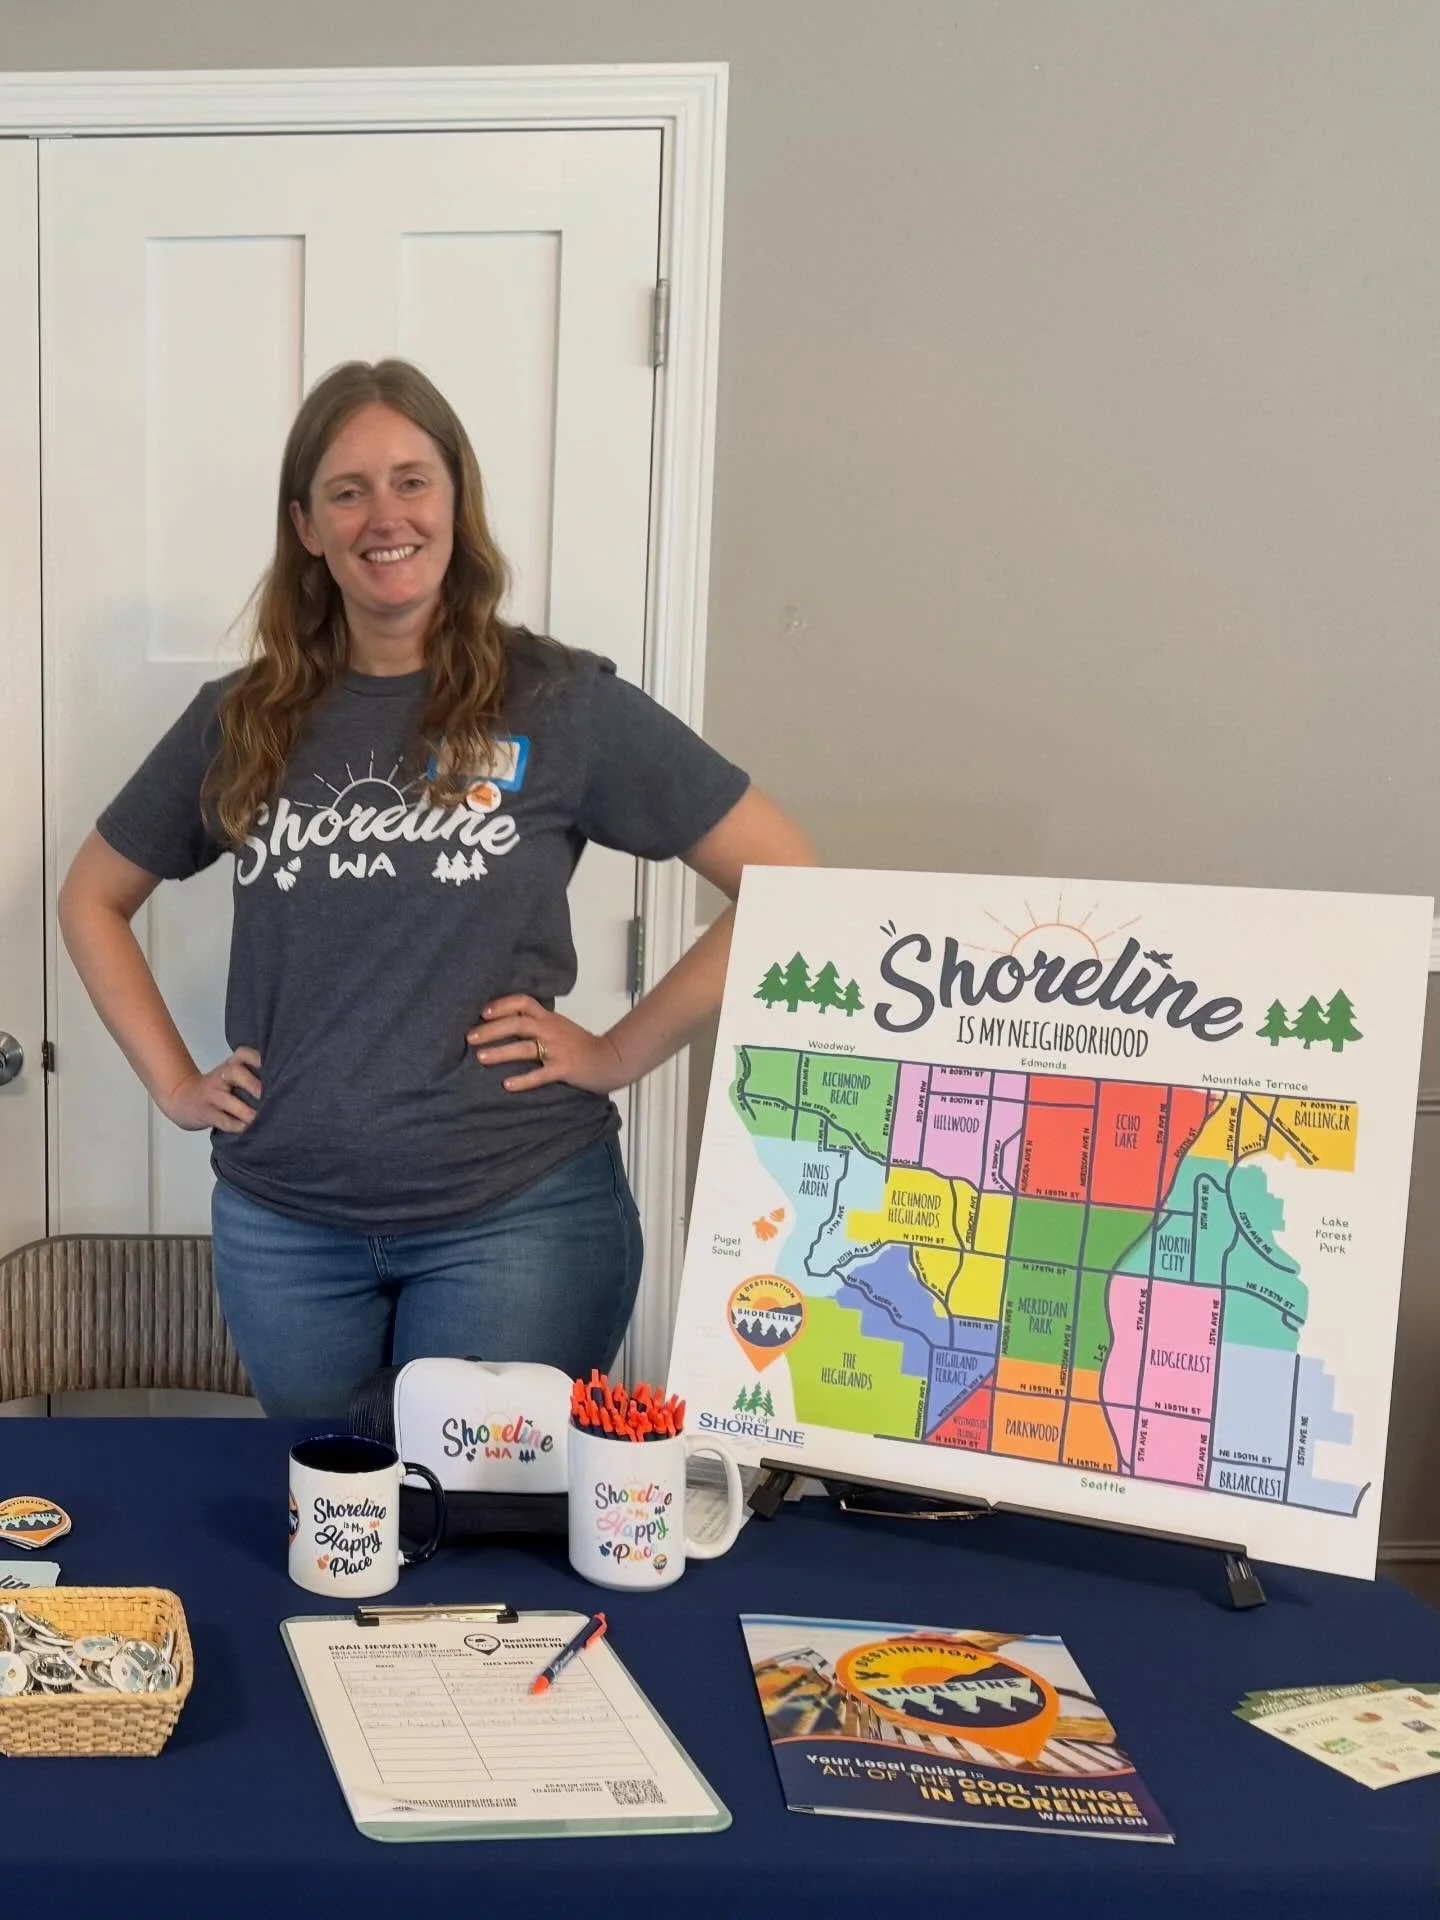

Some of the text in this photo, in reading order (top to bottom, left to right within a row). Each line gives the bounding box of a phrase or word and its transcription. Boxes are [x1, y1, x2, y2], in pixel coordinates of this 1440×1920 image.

[328, 852, 397, 879] WA
[874, 933, 1243, 1042] Shoreline
[808, 1040, 856, 1052] Woodway
[957, 1016, 1148, 1058] IS MY NEIGHBORHOOD
[1021, 1058, 1067, 1070] Edmonds
[822, 1071, 871, 1089] RICHMOND
[920, 1081, 927, 1094] NW
[1202, 1074, 1308, 1091] Mountlake Terrace
[830, 1089, 859, 1105] BEACH
[933, 1114, 980, 1133] HILLWOOD
[1116, 1113, 1141, 1131] ECHO
[1294, 1110, 1351, 1131] BALLINGER
[1114, 1132, 1138, 1149] LAKE
[802, 1162, 829, 1180] INNIS
[798, 1180, 829, 1197] ARDEN
[891, 1190, 942, 1210] RICHMOND
[1201, 1197, 1209, 1212] AVE
[888, 1208, 940, 1228] HIGHLANDS
[1321, 1216, 1349, 1228] Lake
[713, 1233, 742, 1246] Puget
[1159, 1235, 1190, 1253] NORTH
[1315, 1229, 1352, 1242] Forest
[712, 1246, 742, 1257] Sound
[854, 1245, 869, 1254] AVE
[1319, 1244, 1346, 1255] Park
[1161, 1253, 1185, 1272] CITY
[744, 1279, 796, 1299] DESTINATION
[1018, 1296, 1068, 1318] MERIDIAN
[1138, 1300, 1146, 1314] AVE
[1213, 1300, 1220, 1309] NE
[737, 1308, 796, 1322] SHORELINE
[1136, 1318, 1144, 1330] 5TH
[1211, 1312, 1219, 1326] AVE
[1028, 1317, 1052, 1335] PARK
[842, 1352, 857, 1370] THE
[935, 1352, 978, 1370] HIGHLAND
[1150, 1349, 1211, 1374] RIDGECREST
[821, 1367, 873, 1391] HIGHLANDS
[935, 1368, 969, 1386] TERRACE
[735, 1412, 769, 1425] CITY OF
[1191, 1407, 1201, 1415] ST
[699, 1413, 806, 1445] SHORELINE
[1005, 1418, 1059, 1442] PARKWOOD
[1142, 1418, 1149, 1428] NE
[1301, 1416, 1309, 1426] NE
[442, 1415, 554, 1458] Shoreline
[1140, 1431, 1148, 1447] AVE
[1200, 1434, 1208, 1446] NE
[1299, 1429, 1307, 1446] AVE
[485, 1447, 512, 1459] WA
[1198, 1448, 1206, 1464] AVE
[1219, 1449, 1230, 1458] NE
[1262, 1456, 1272, 1464] ST
[1080, 1477, 1127, 1495] Seattle
[1219, 1471, 1281, 1498] BRIARCREST
[313, 1497, 387, 1524] Shoreline
[351, 1522, 364, 1534] My
[314, 1524, 383, 1556] Happy
[329, 1556, 373, 1578] Place
[364, 1642, 437, 1650] NEWSLETTER
[858, 1645, 979, 1668] DESTINATION
[877, 1677, 1021, 1697] SHORELINE
[806, 1754, 850, 1766] Your
[855, 1757, 906, 1772] Local
[910, 1763, 967, 1777] Guide
[822, 1764, 1134, 1803] ALL OF THE COOL THINGS
[920, 1785, 1143, 1817] IN SHORELINE
[1037, 1811, 1149, 1827] WASHINGTON
